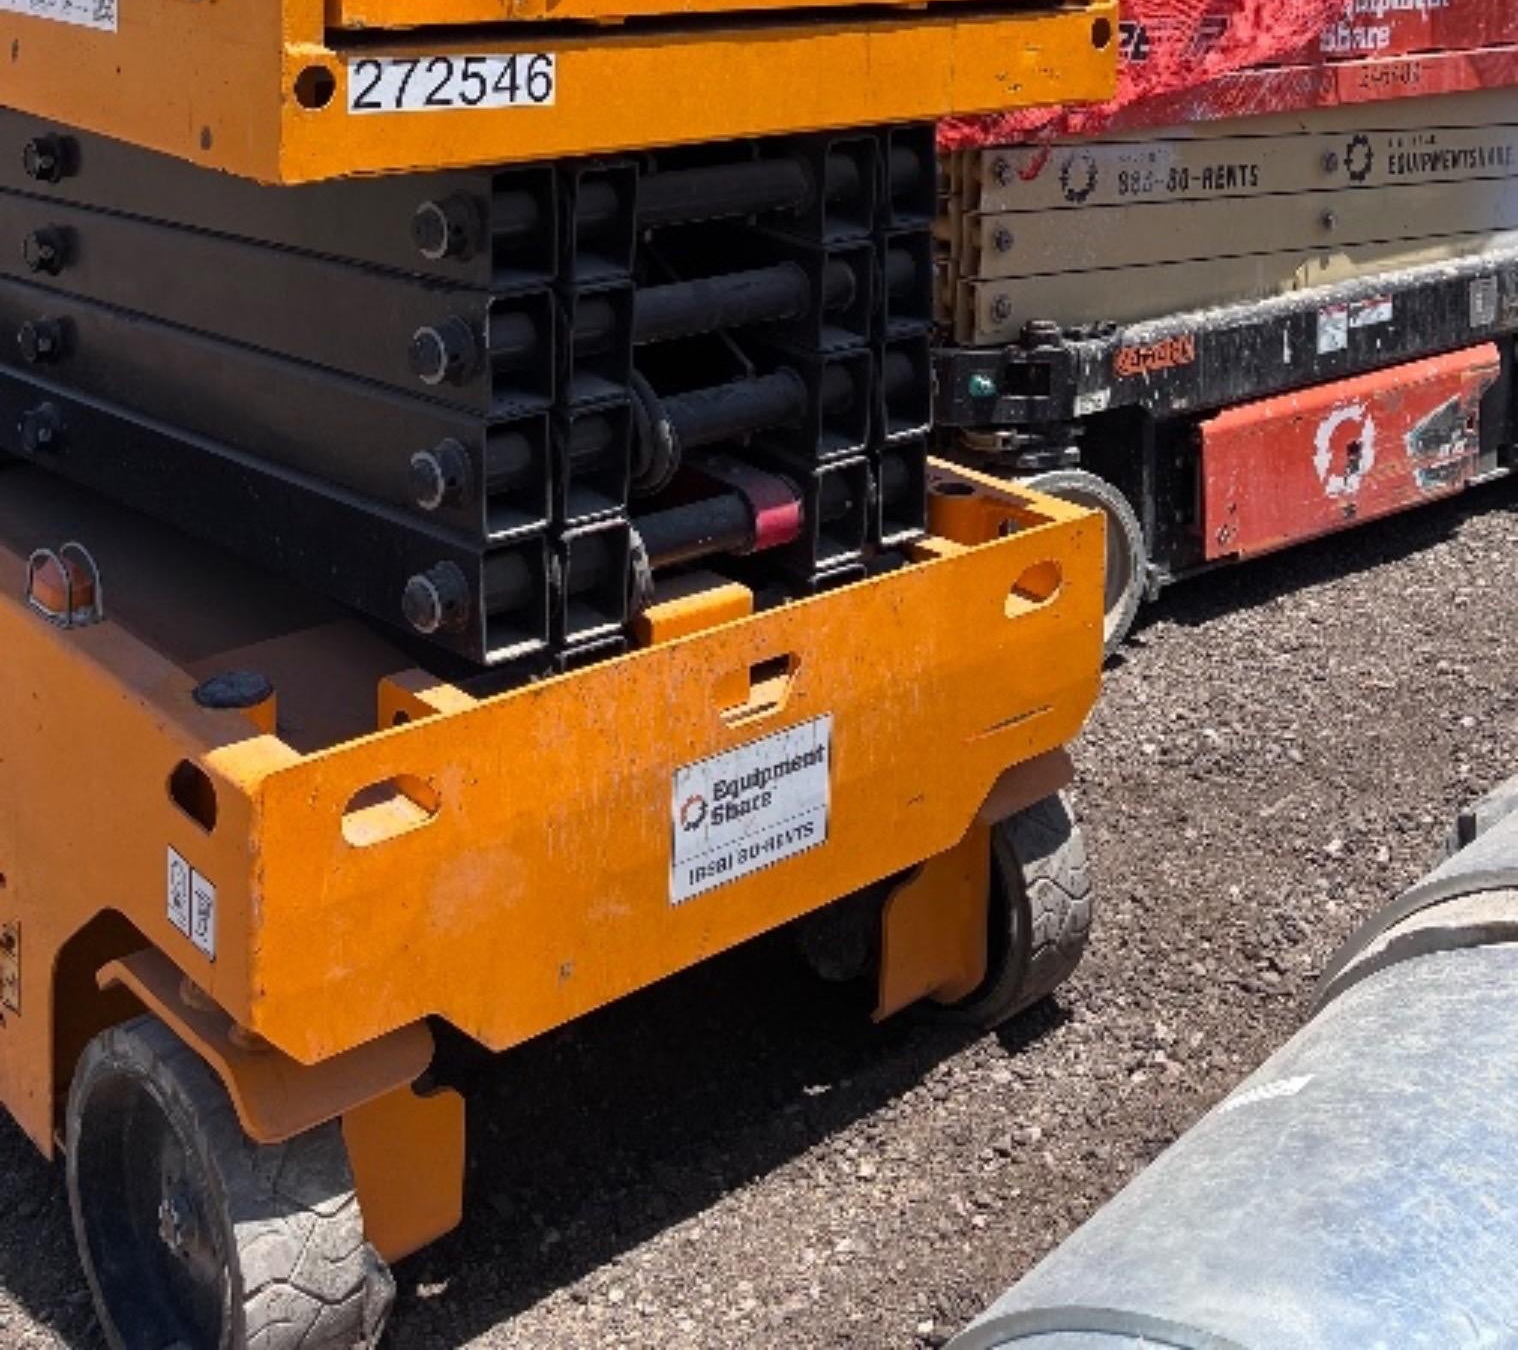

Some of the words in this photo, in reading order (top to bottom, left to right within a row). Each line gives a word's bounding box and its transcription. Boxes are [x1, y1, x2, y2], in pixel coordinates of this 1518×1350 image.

[352, 53, 553, 109] 272546
[712, 743, 825, 803] Equipment
[709, 791, 773, 827] Share
